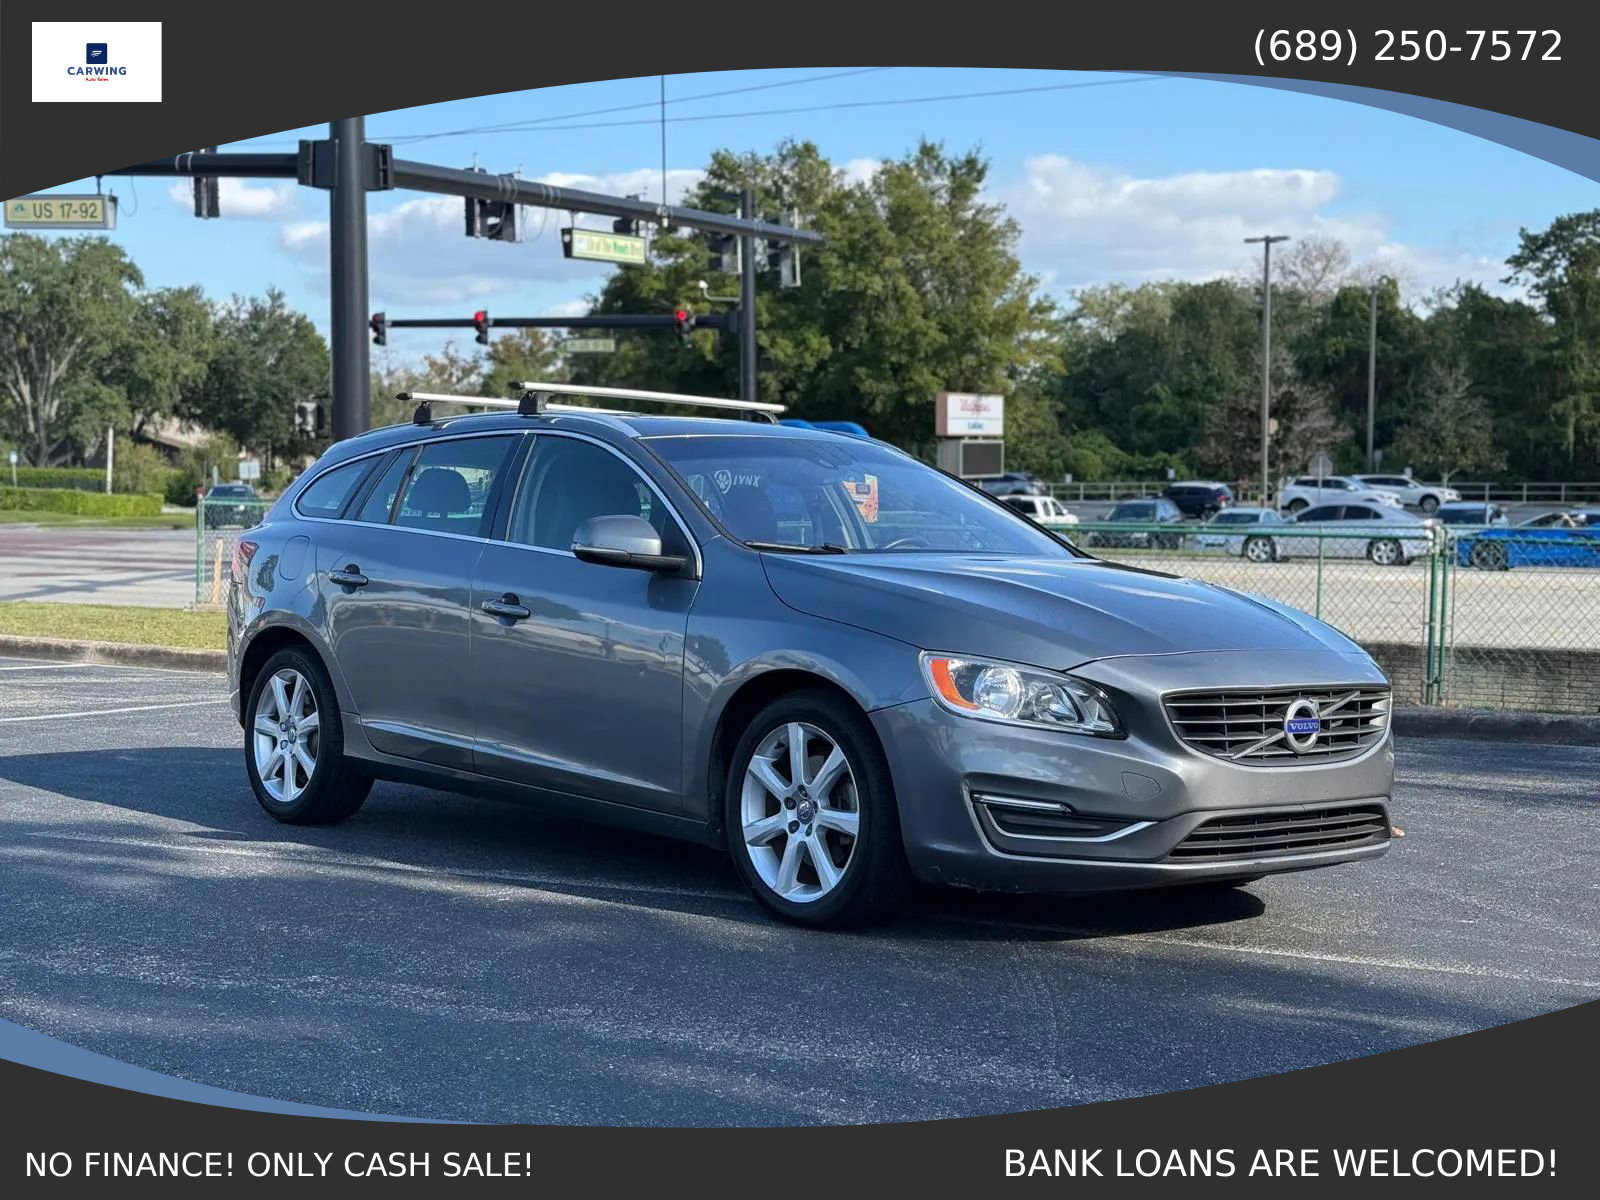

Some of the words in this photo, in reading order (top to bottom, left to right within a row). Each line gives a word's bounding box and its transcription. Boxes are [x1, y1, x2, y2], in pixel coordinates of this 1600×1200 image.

[32, 202, 53, 219] US
[60, 202, 98, 219] 17-92
[1290, 722, 1319, 730] VOLVO
